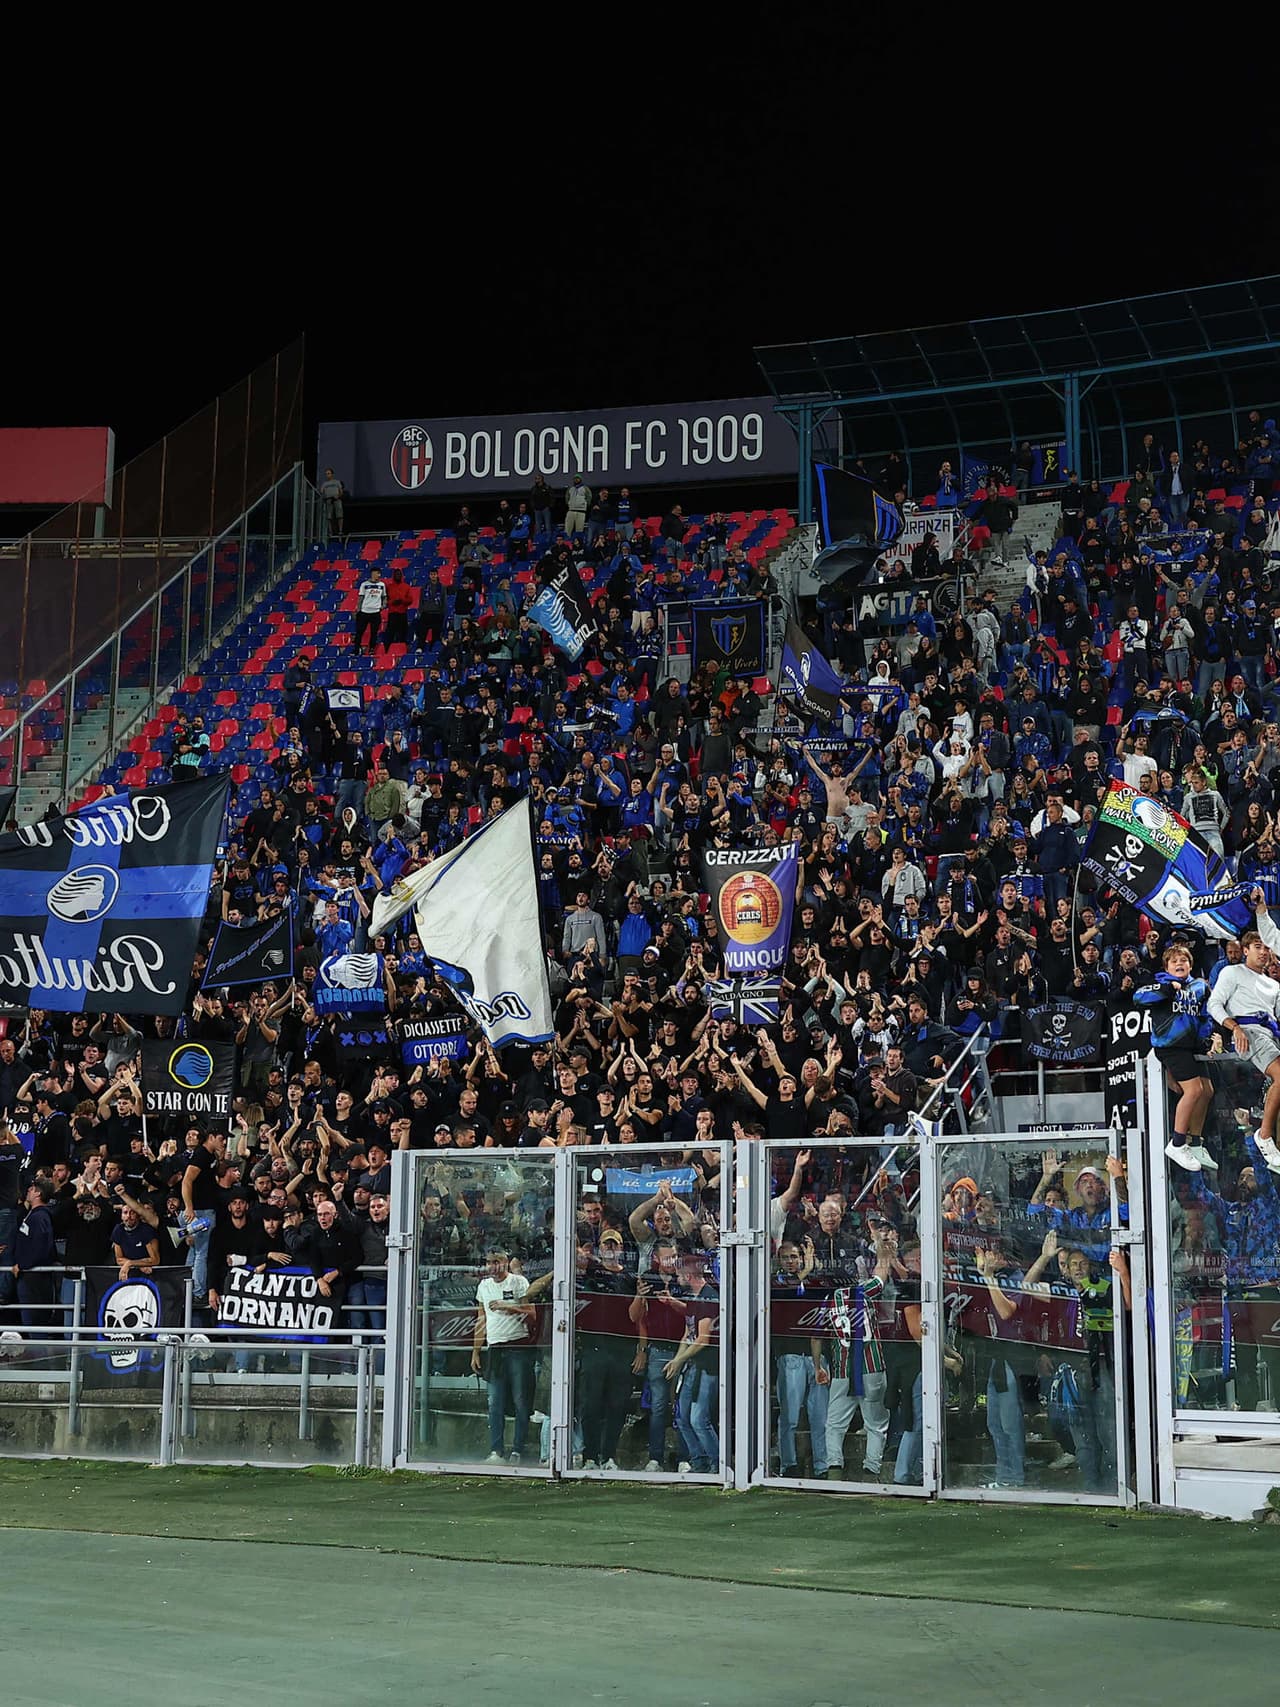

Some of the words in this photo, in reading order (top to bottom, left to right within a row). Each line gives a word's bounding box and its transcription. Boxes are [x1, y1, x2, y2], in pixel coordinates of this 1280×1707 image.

[403, 428, 422, 441] BFC
[445, 424, 609, 479] BOLOGNA
[626, 420, 666, 468] FC
[679, 413, 763, 466] 1909
[1116, 788, 1138, 803] YOU
[1105, 807, 1134, 824] WALK
[706, 844, 795, 866] CERIZZATI
[1104, 871, 1120, 891] THE
[1118, 885, 1139, 904] END
[737, 910, 760, 920] CERES
[1026, 1004, 1051, 1020] UNTIL
[1056, 1003, 1074, 1013] THE
[1076, 1005, 1096, 1021] END
[403, 1018, 462, 1038] DICIASSETTE
[1052, 1044, 1096, 1061] ATALANTA
[147, 1091, 182, 1110] STAR
[186, 1092, 211, 1112] CON
[214, 1094, 229, 1113] TE
[230, 1267, 318, 1298] TANTO
